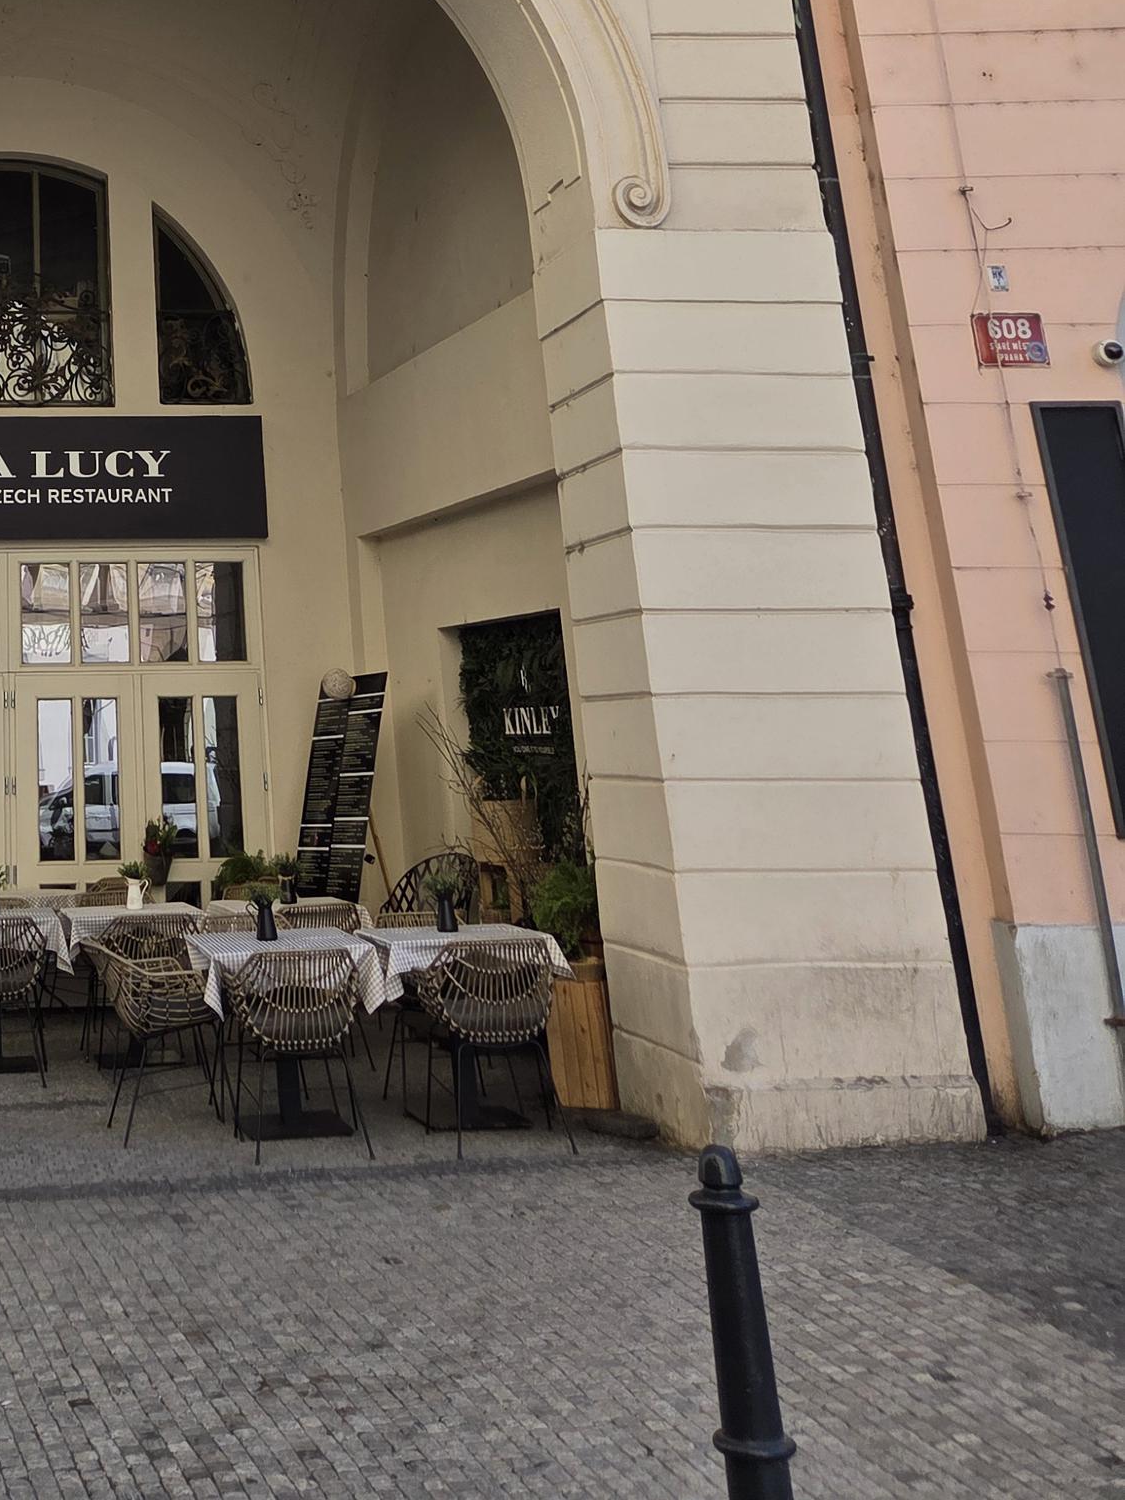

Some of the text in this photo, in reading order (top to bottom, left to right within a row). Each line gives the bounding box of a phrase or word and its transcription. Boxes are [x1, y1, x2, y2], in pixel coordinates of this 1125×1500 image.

[987, 318, 1032, 339] 608
[30, 450, 172, 478] LUCY
[48, 487, 173, 504] RESTAURANT
